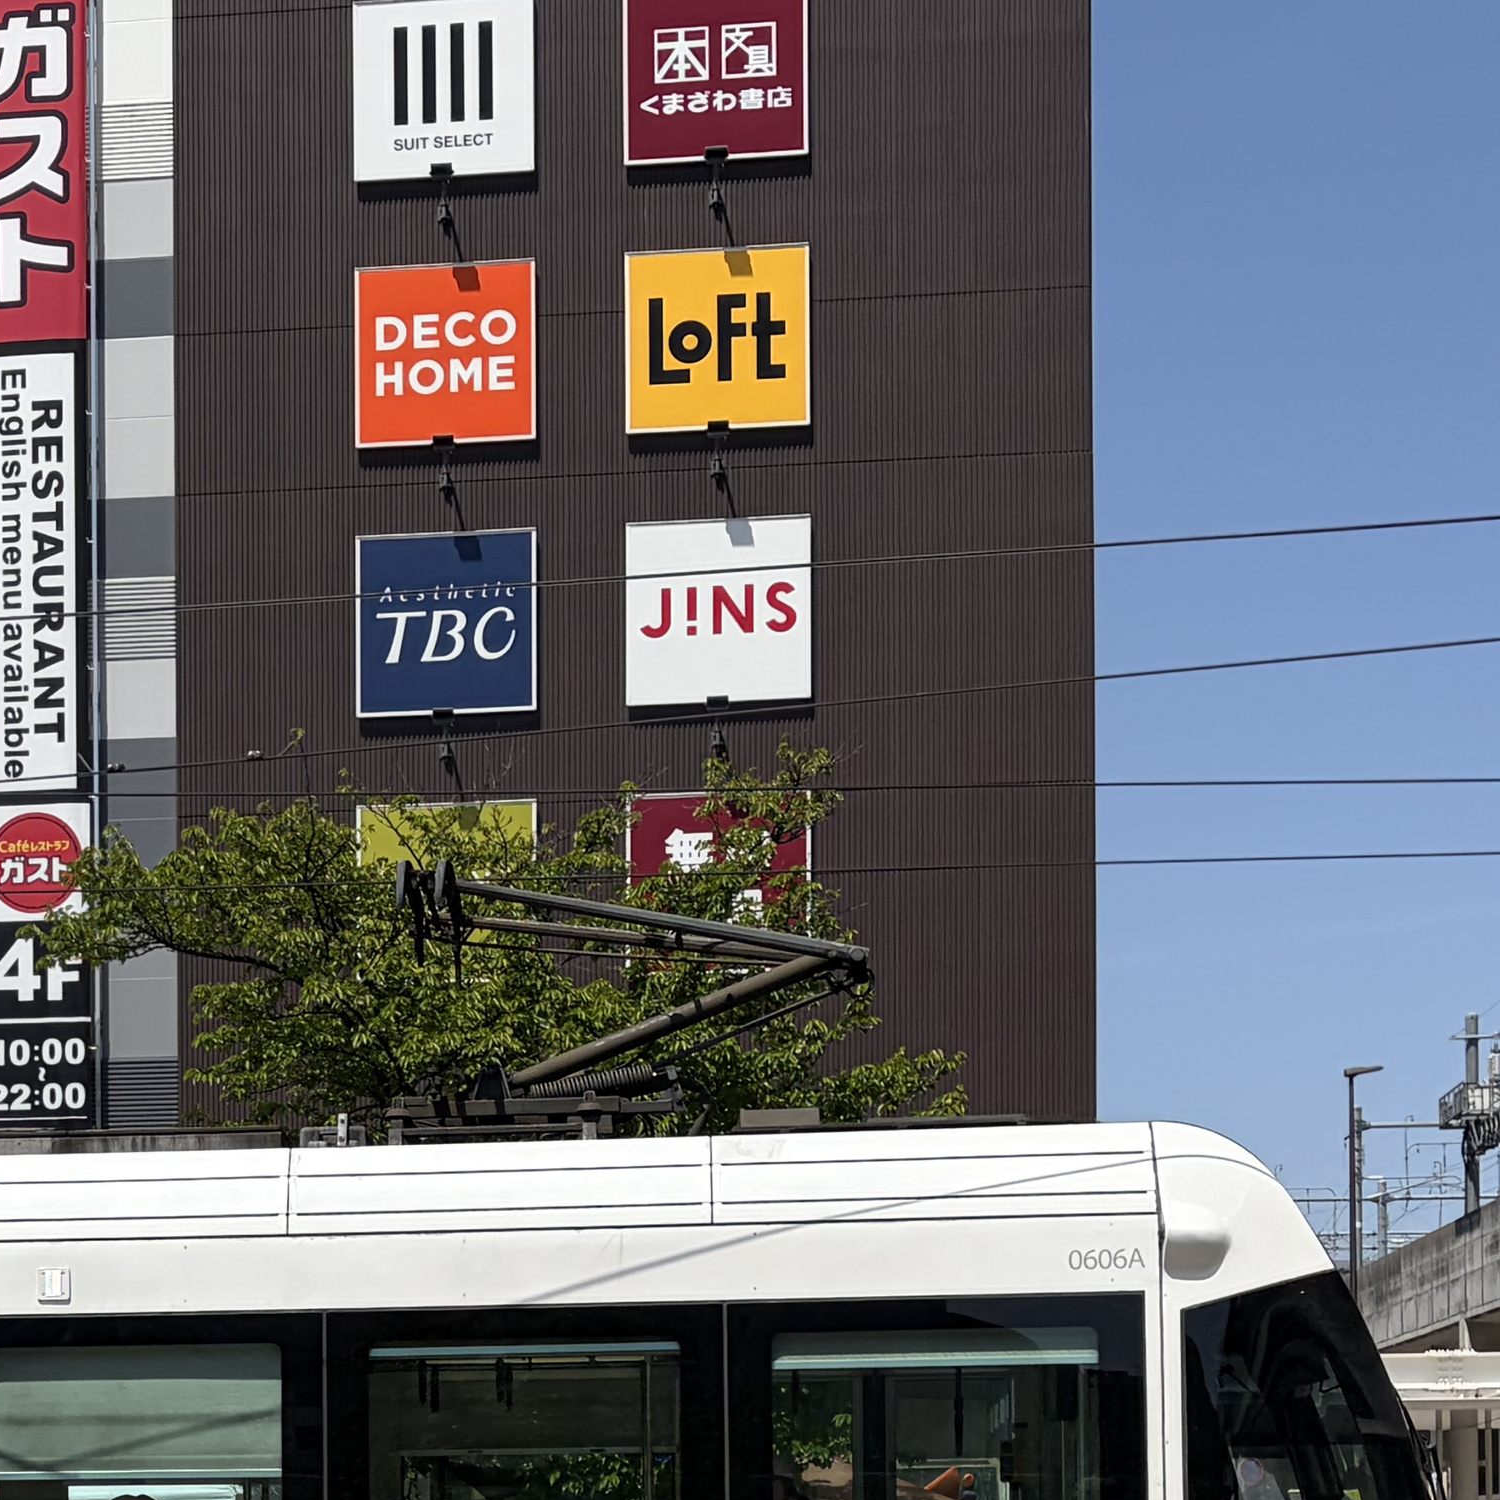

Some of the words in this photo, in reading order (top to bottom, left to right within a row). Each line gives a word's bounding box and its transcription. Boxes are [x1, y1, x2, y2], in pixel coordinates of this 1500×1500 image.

[640, 86, 792, 115] くまざわ書店
[393, 137, 429, 151] SUIT
[433, 133, 493, 149] SELECT
[375, 309, 517, 352] DECO
[375, 355, 516, 397] HOME
[2, 514, 22, 610] menu
[31, 400, 65, 742] RESTAURANT
[640, 581, 797, 639] J!NS
[376, 606, 516, 664] TBC
[3, 623, 29, 778] available
[0, 856, 70, 884] ガスト
[1068, 1248, 1145, 1270] 0606A
